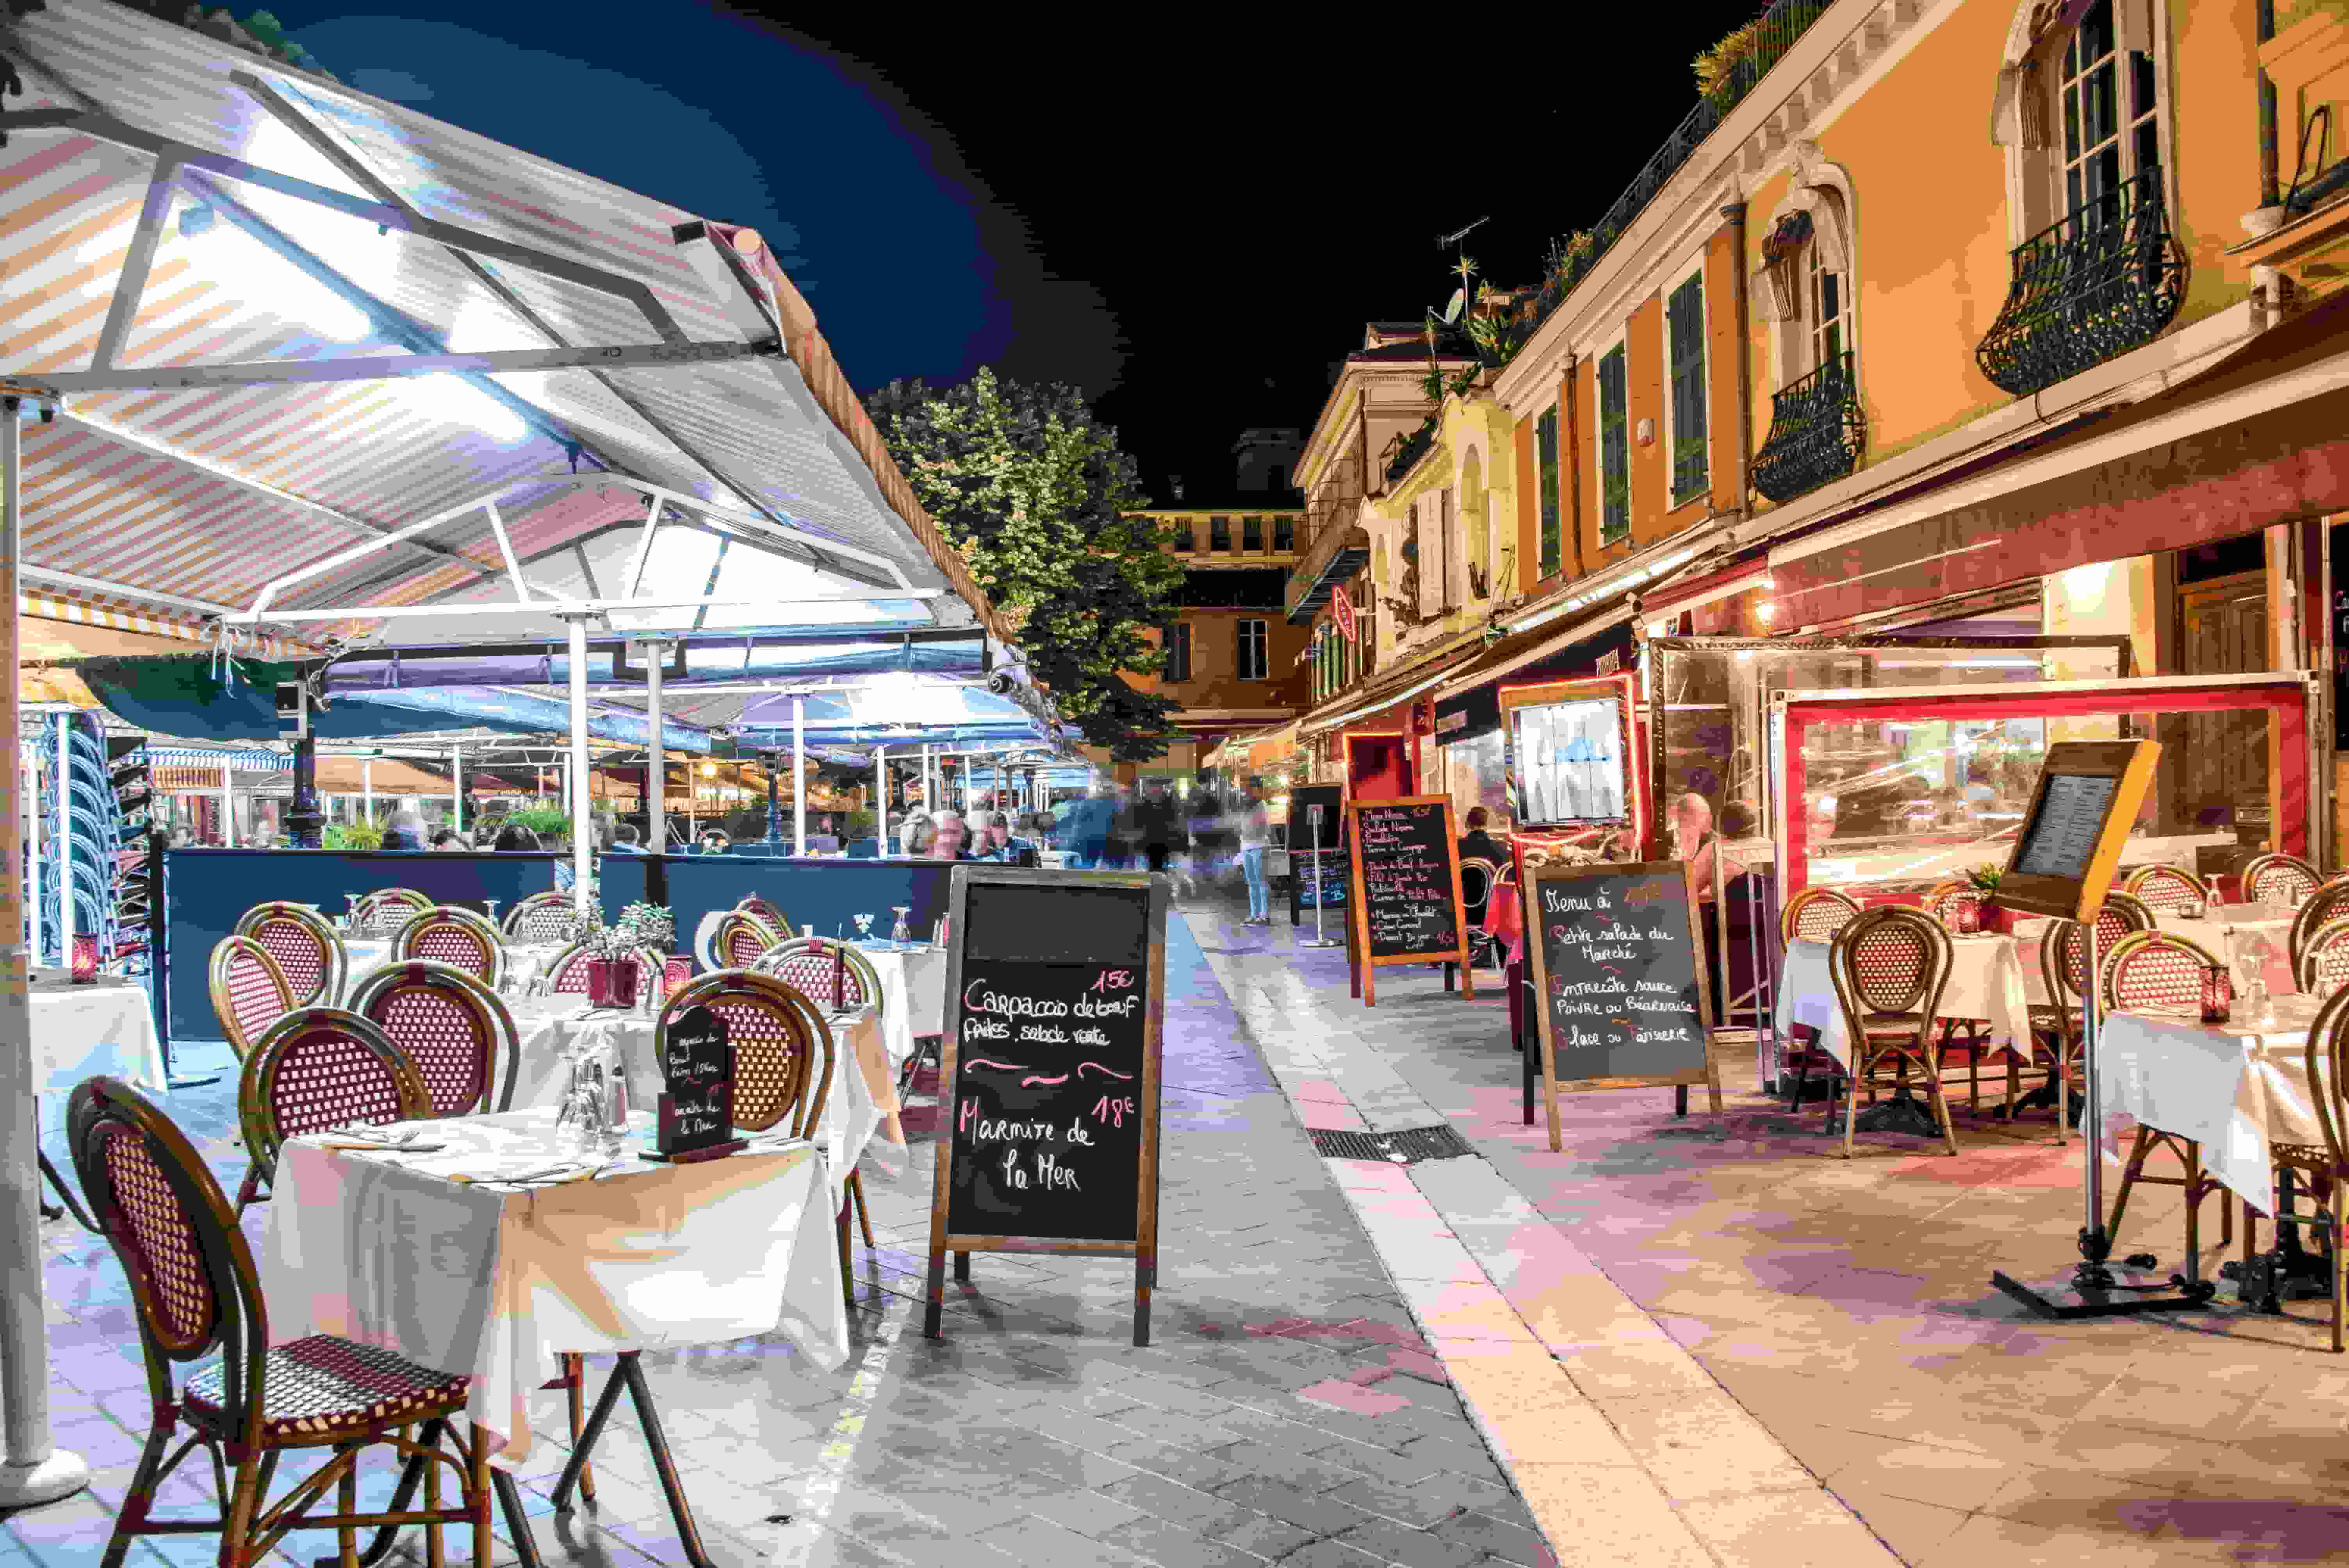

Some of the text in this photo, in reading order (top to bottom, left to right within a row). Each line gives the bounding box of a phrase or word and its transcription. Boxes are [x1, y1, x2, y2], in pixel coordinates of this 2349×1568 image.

[1546, 887, 1612, 912] Menu à
[1596, 923, 1643, 941] salade
[1649, 925, 1674, 941] du
[1582, 943, 1637, 963] Marché
[1090, 970, 1134, 994] 15€
[1634, 980, 1678, 994] sauce
[965, 978, 1068, 1024] Carpaccio
[1073, 992, 1093, 1017] de
[1556, 996, 1696, 1016] Poivre ou Béarnaise
[1019, 1024, 1071, 1044] salade
[1607, 1032, 1622, 1043] ou
[959, 1097, 1096, 1146] Marmite de
[1002, 1150, 1081, 1191] la Mer
